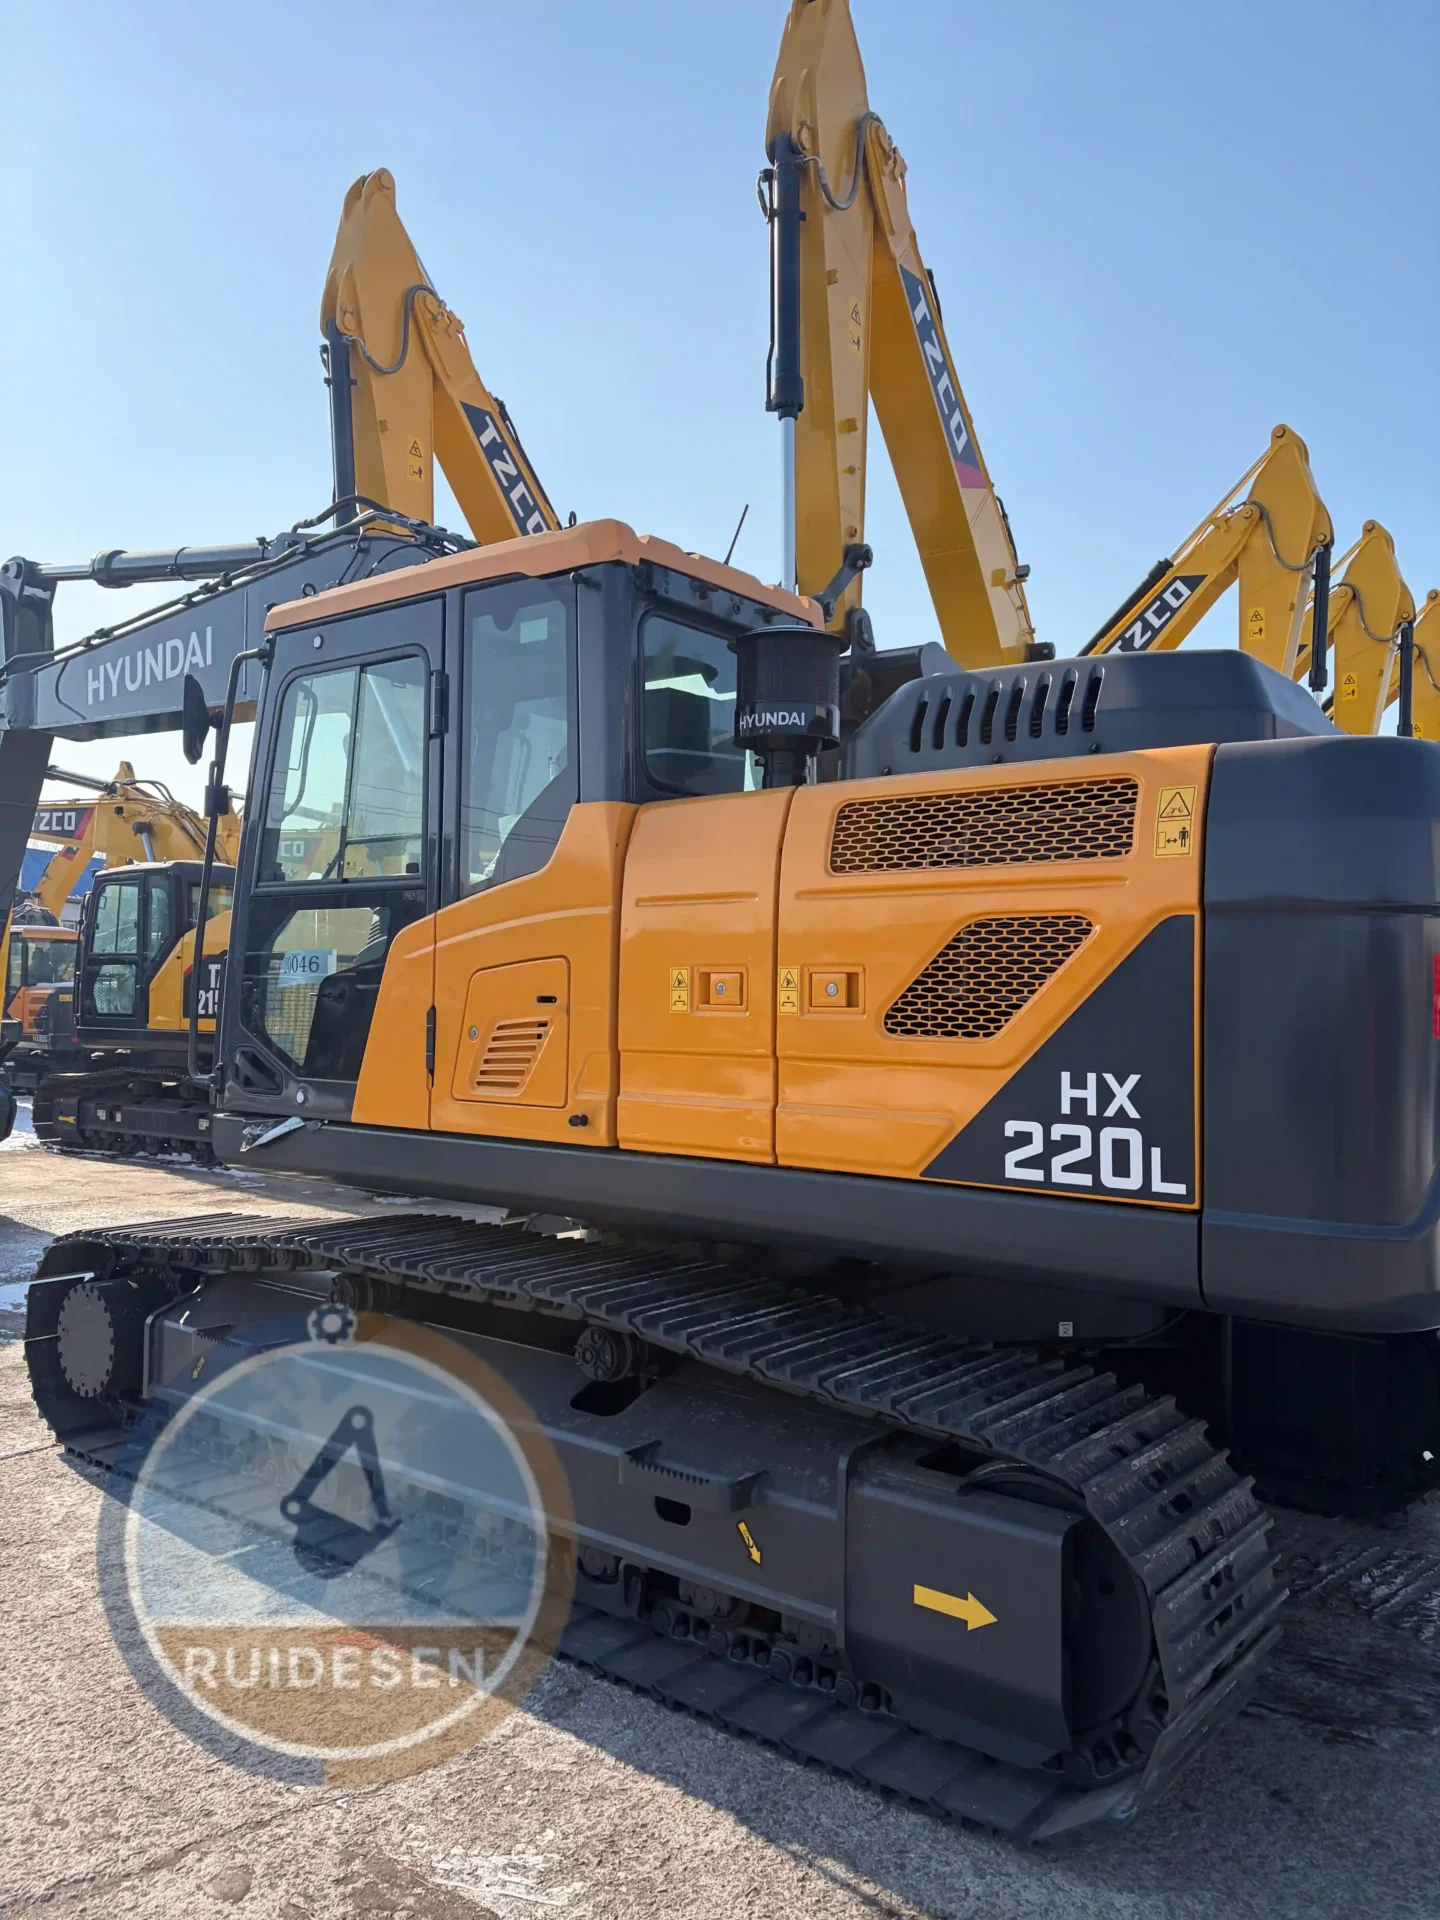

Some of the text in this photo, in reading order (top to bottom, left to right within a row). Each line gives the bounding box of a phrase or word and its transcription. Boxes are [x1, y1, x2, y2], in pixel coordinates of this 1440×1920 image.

[914, 285, 968, 455] TZCO
[87, 625, 212, 705] HYUNDAI
[740, 711, 805, 730] HYUNDAI
[1060, 1071, 1142, 1119] HX
[1004, 1119, 1187, 1195] 220L
